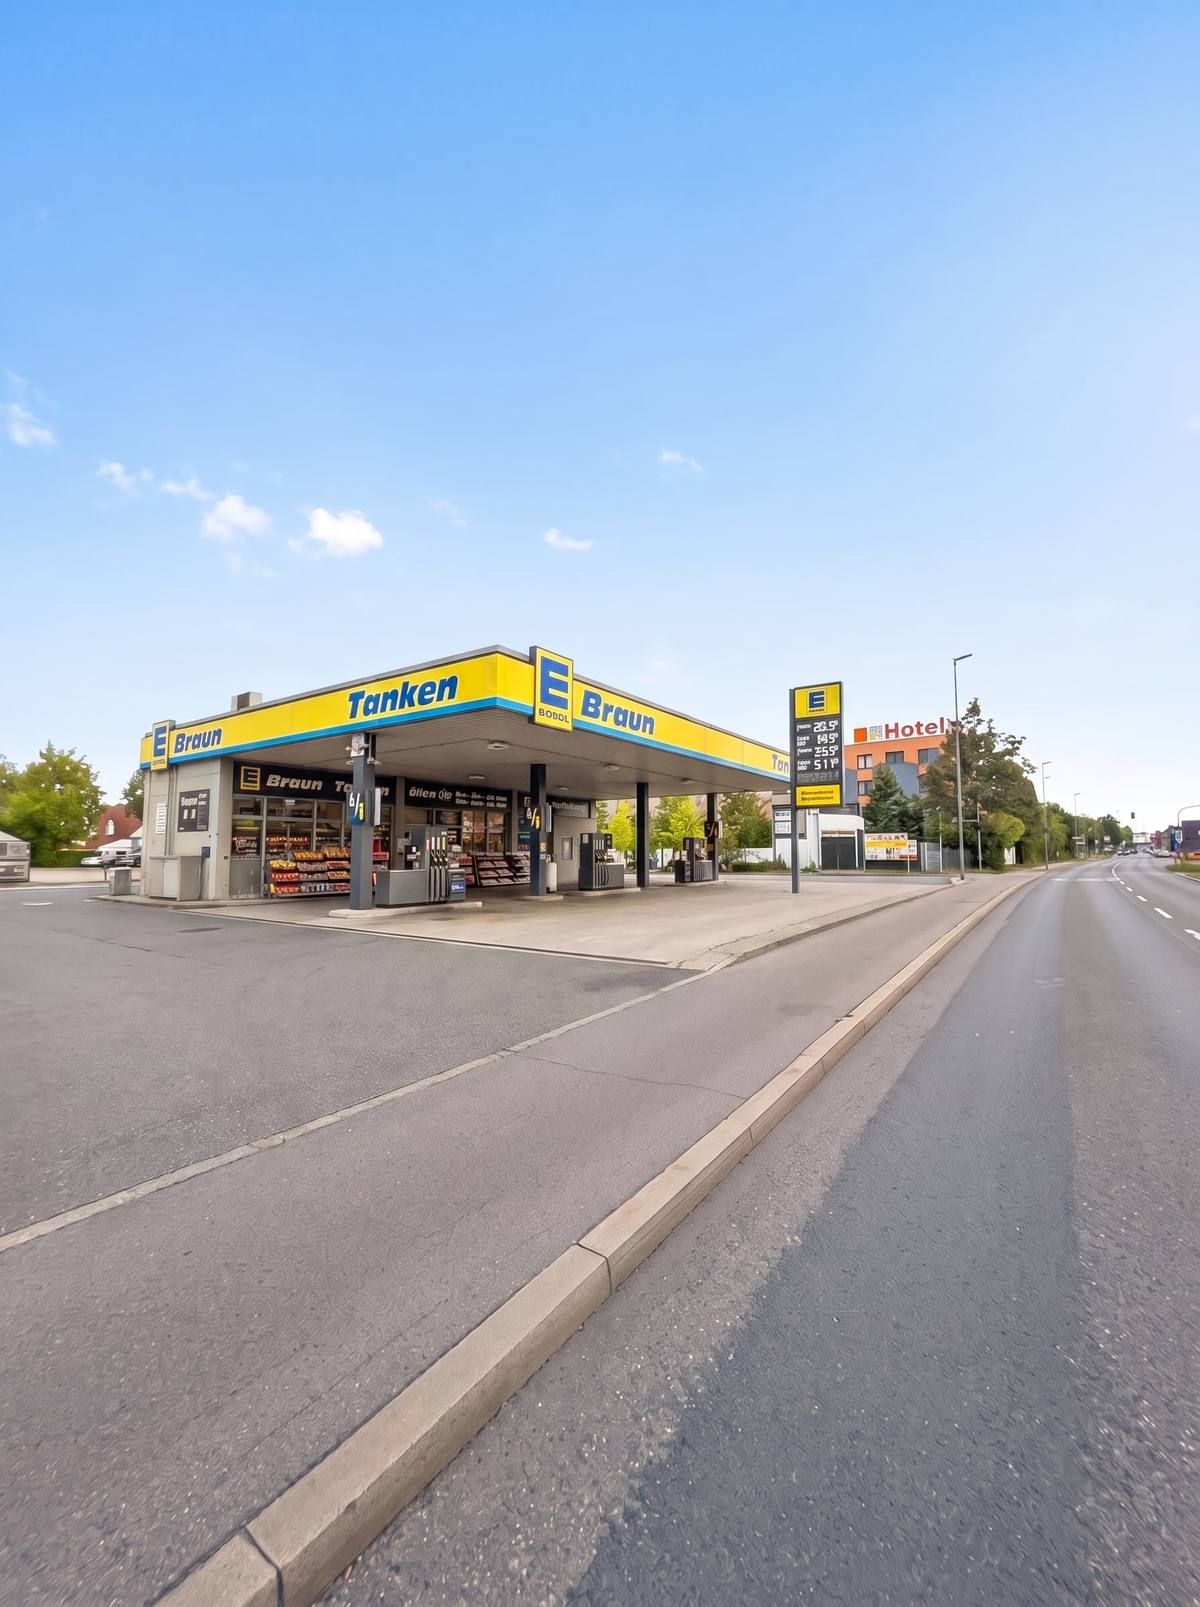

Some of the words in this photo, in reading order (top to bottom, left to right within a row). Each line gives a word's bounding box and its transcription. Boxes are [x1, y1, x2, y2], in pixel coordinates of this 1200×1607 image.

[540, 655, 569, 710] E
[347, 673, 459, 720] Tanken
[808, 690, 825, 708] E
[580, 689, 656, 736] Braun
[153, 725, 168, 757] E
[174, 727, 223, 754] Braun
[884, 716, 944, 739] Hotel
[771, 753, 790, 775] Tan
[266, 773, 323, 791] Braun
